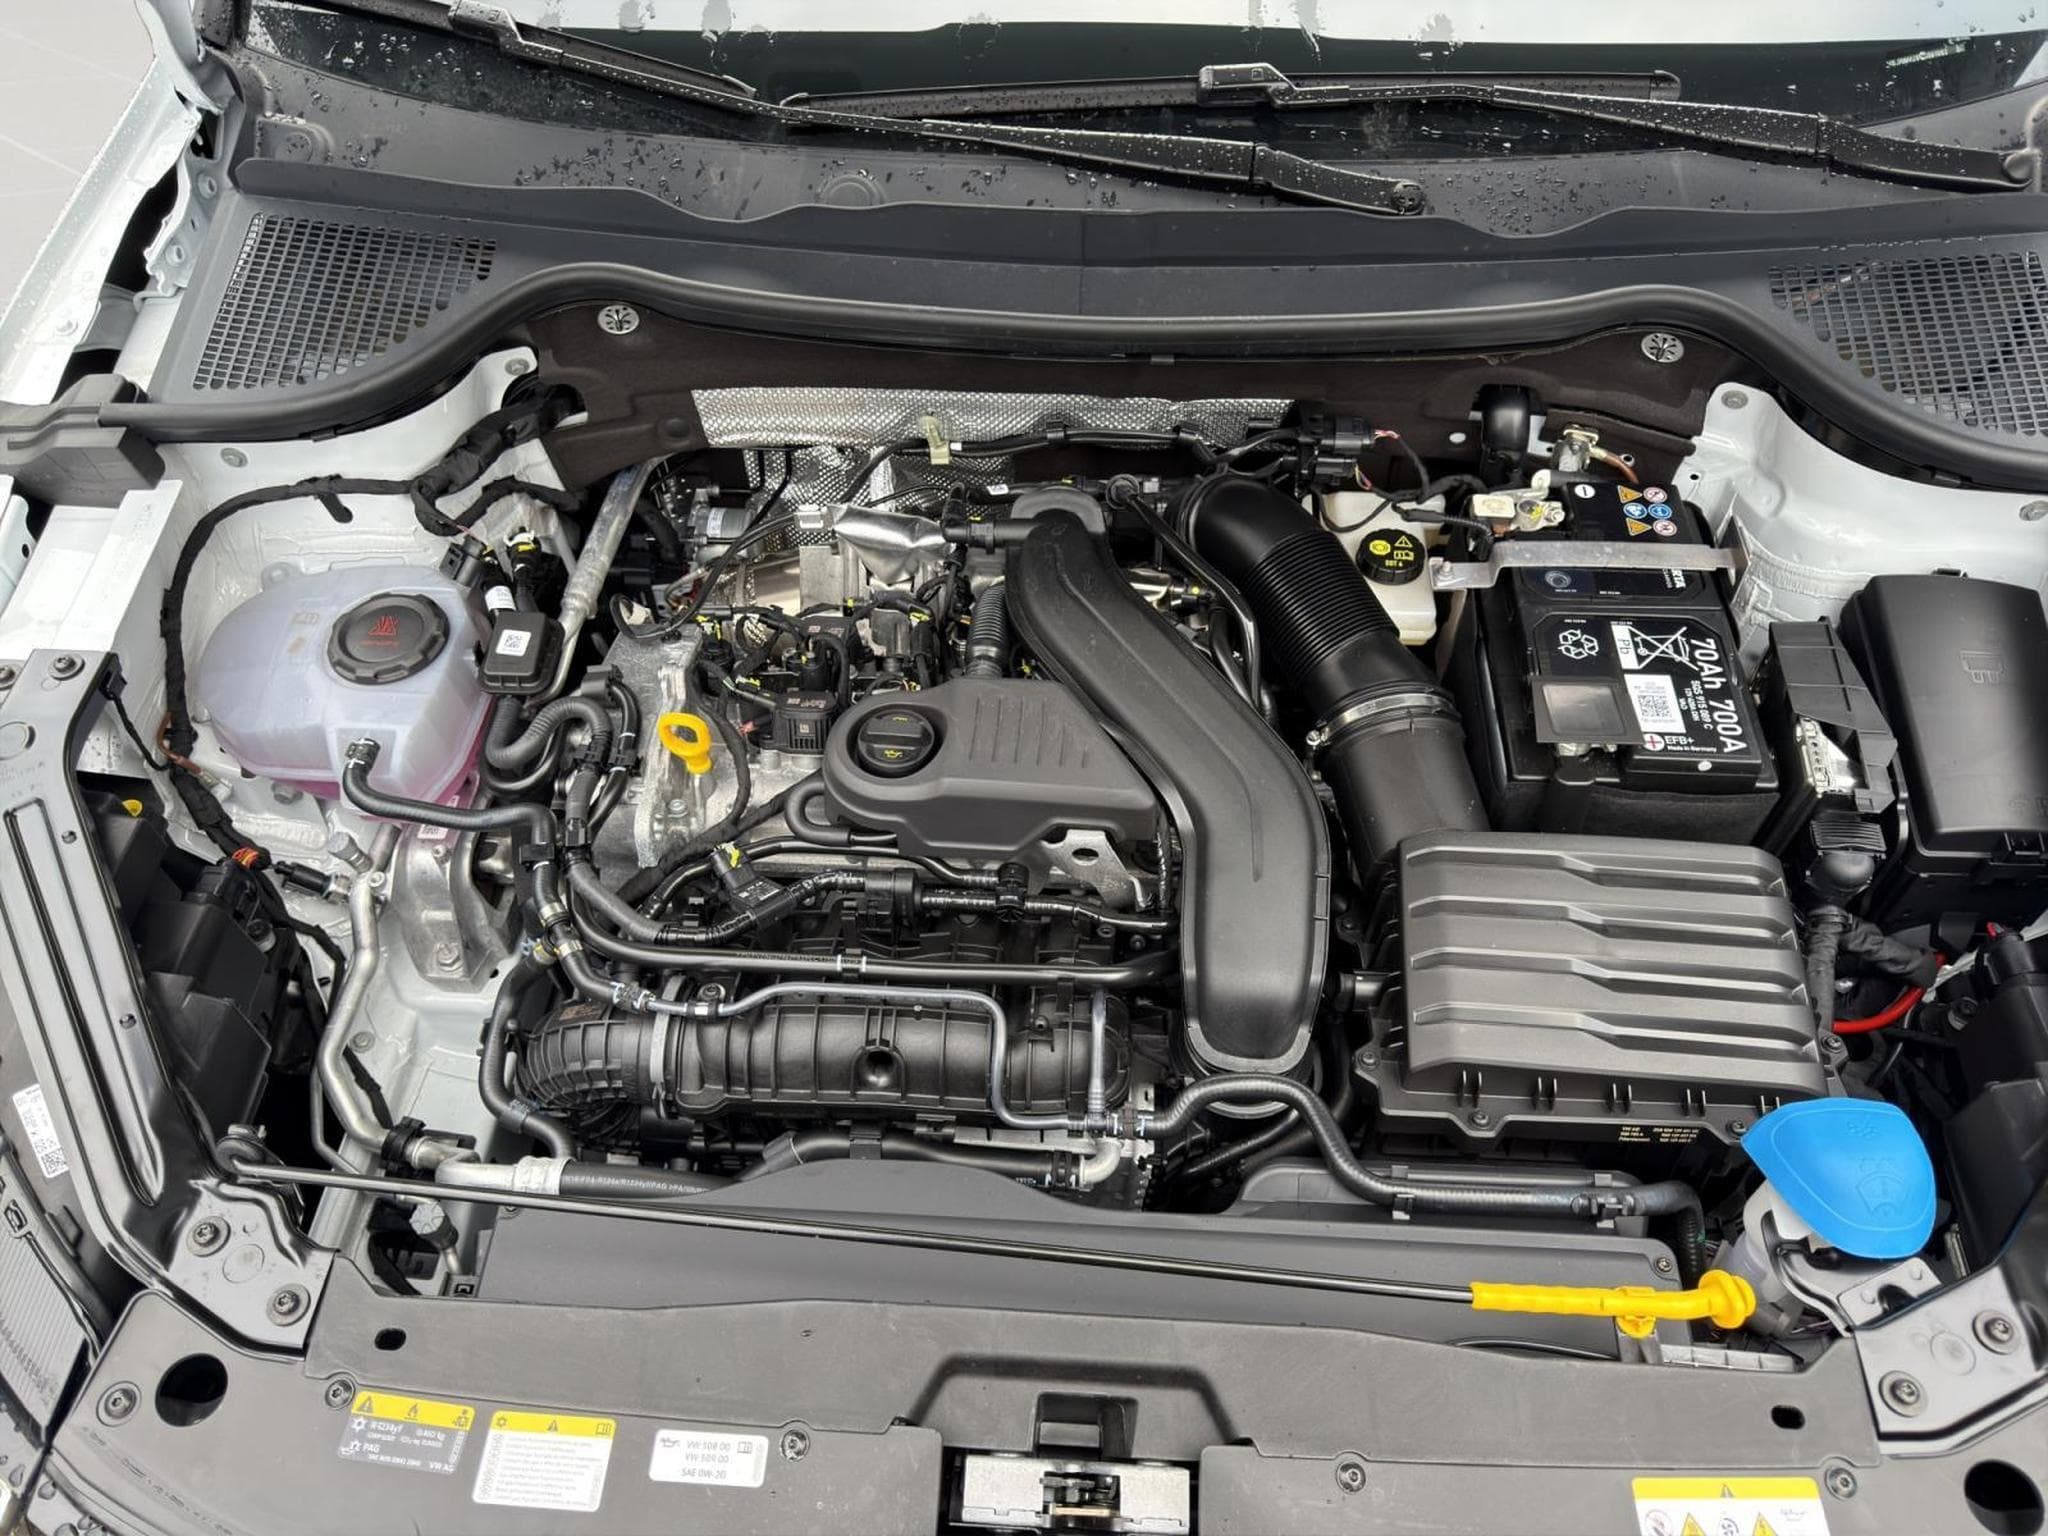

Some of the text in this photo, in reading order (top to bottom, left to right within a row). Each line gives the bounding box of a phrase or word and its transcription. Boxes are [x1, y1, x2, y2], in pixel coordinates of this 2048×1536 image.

[1671, 567, 1686, 589] RTA
[1617, 637, 1632, 655] Pb
[1690, 637, 1748, 753] 70Ah 700A
[1664, 735, 1695, 745] EFB+
[1690, 745, 1718, 753] Germany
[362, 1442, 380, 1453] PAG
[685, 1452, 698, 1462] VW
[717, 1454, 730, 1464] 00
[681, 1467, 728, 1480] SAE 0W-20
